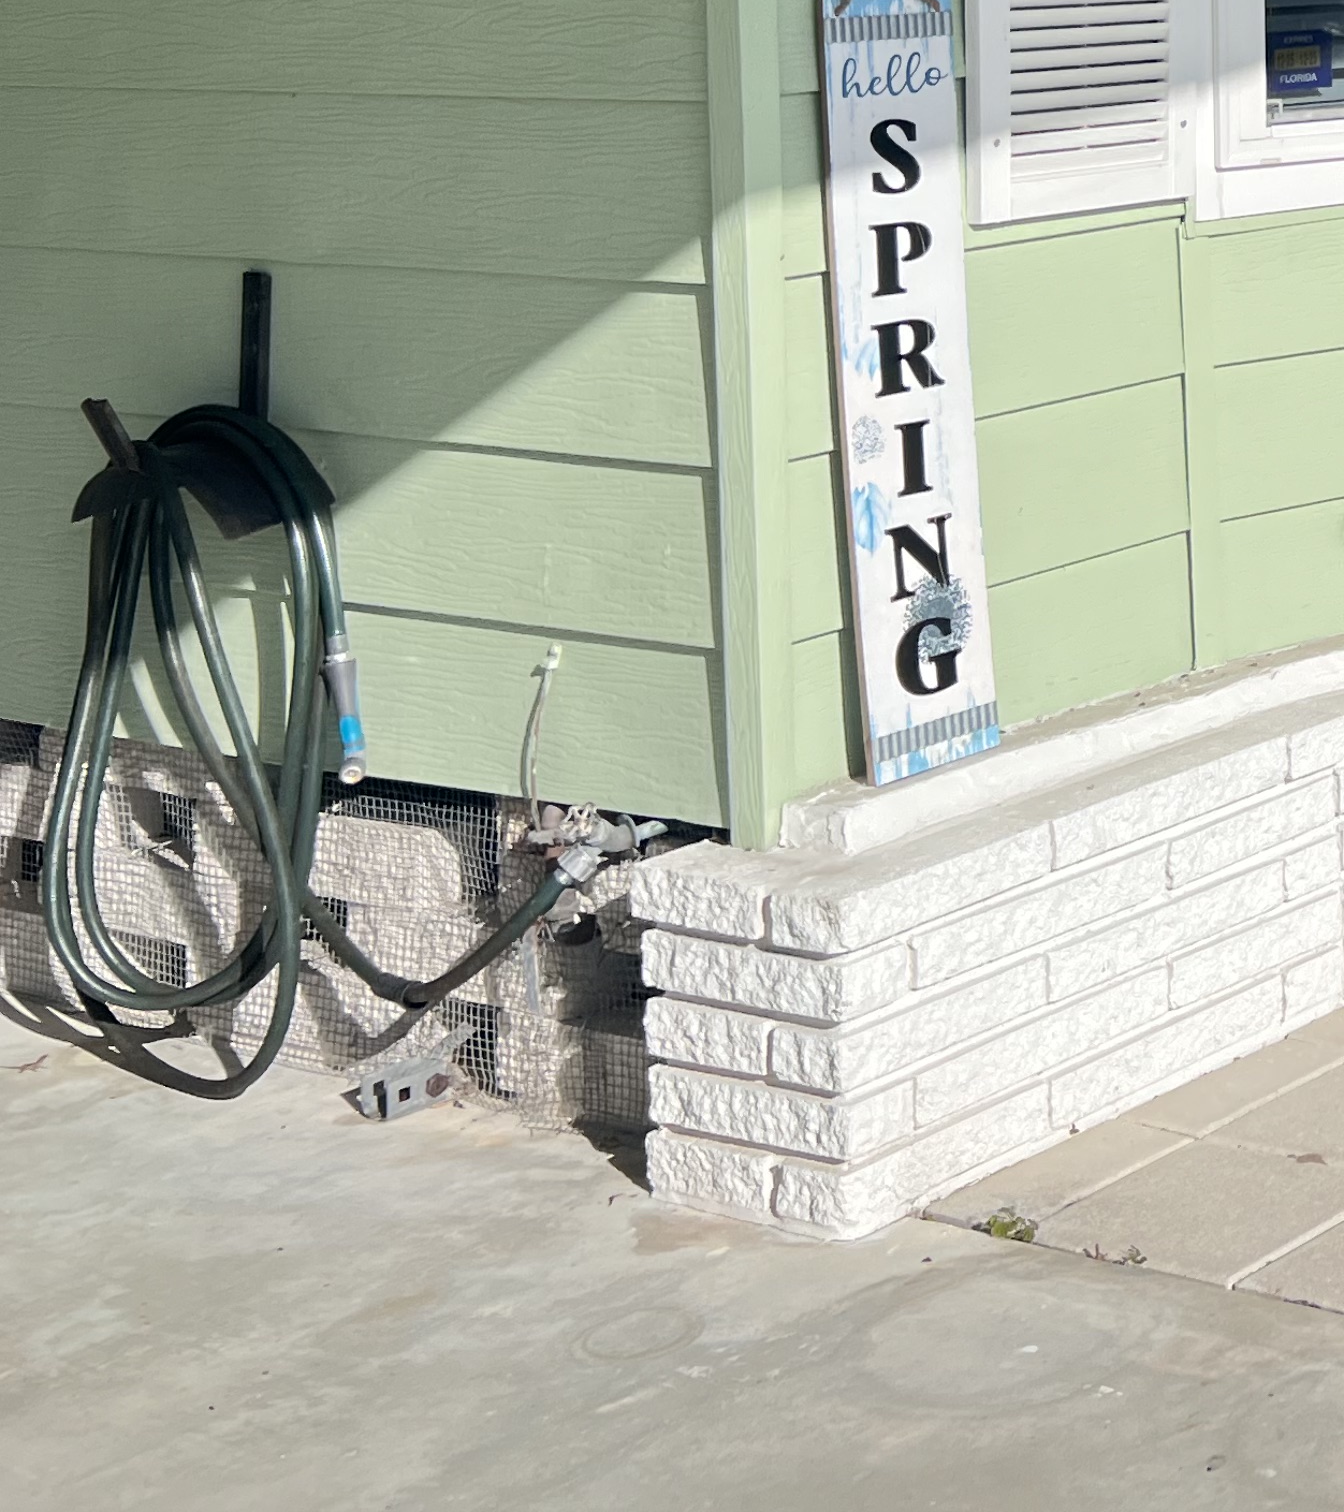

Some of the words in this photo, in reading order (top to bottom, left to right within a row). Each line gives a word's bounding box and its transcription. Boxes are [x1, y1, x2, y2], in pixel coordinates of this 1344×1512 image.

[841, 51, 949, 99] hello
[1279, 72, 1318, 84] FLORIDA
[868, 118, 963, 696] SPRING
